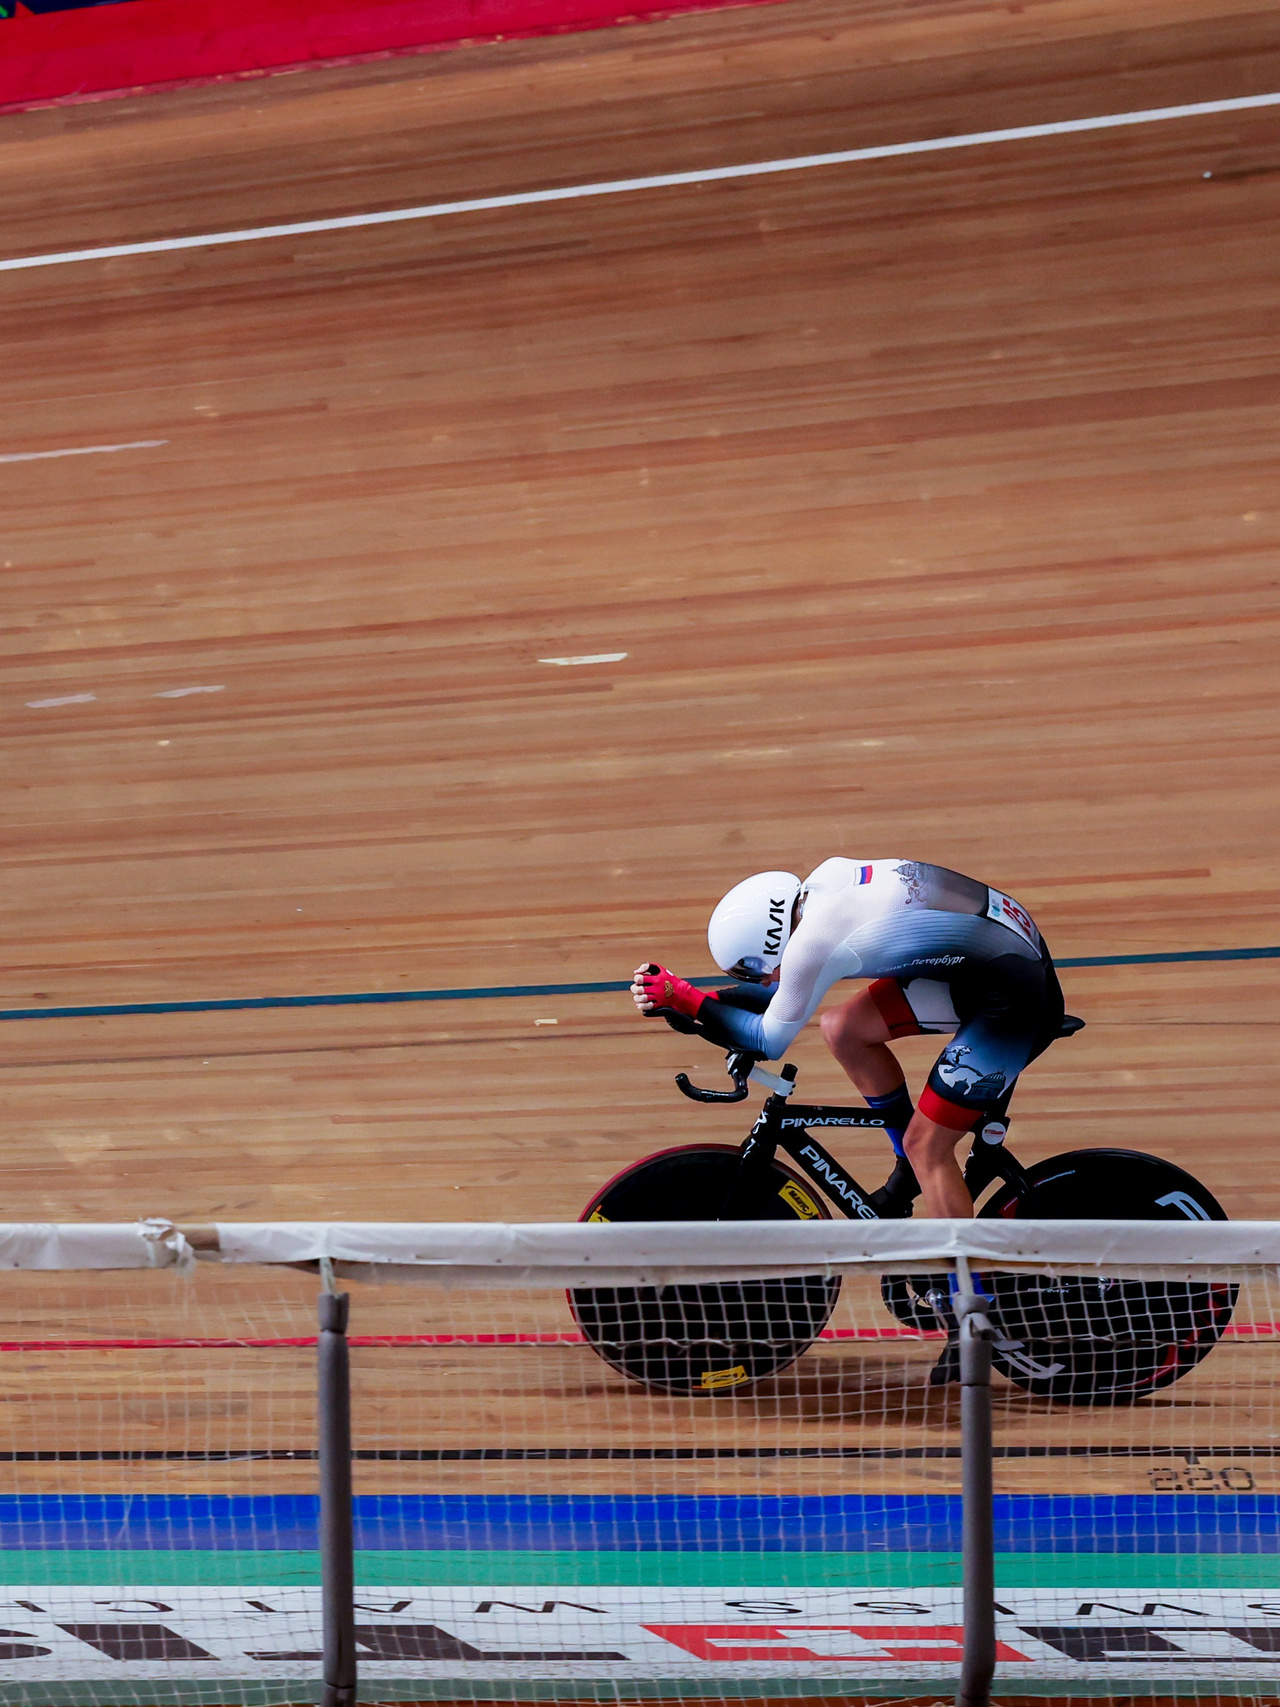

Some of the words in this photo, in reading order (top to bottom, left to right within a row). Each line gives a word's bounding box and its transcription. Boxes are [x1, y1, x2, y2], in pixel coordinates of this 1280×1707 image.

[763, 898, 785, 956] KASK
[780, 1117, 885, 1129] PINARELLO
[799, 1144, 880, 1220] PINARE
[1147, 1467, 1254, 1491] 220
